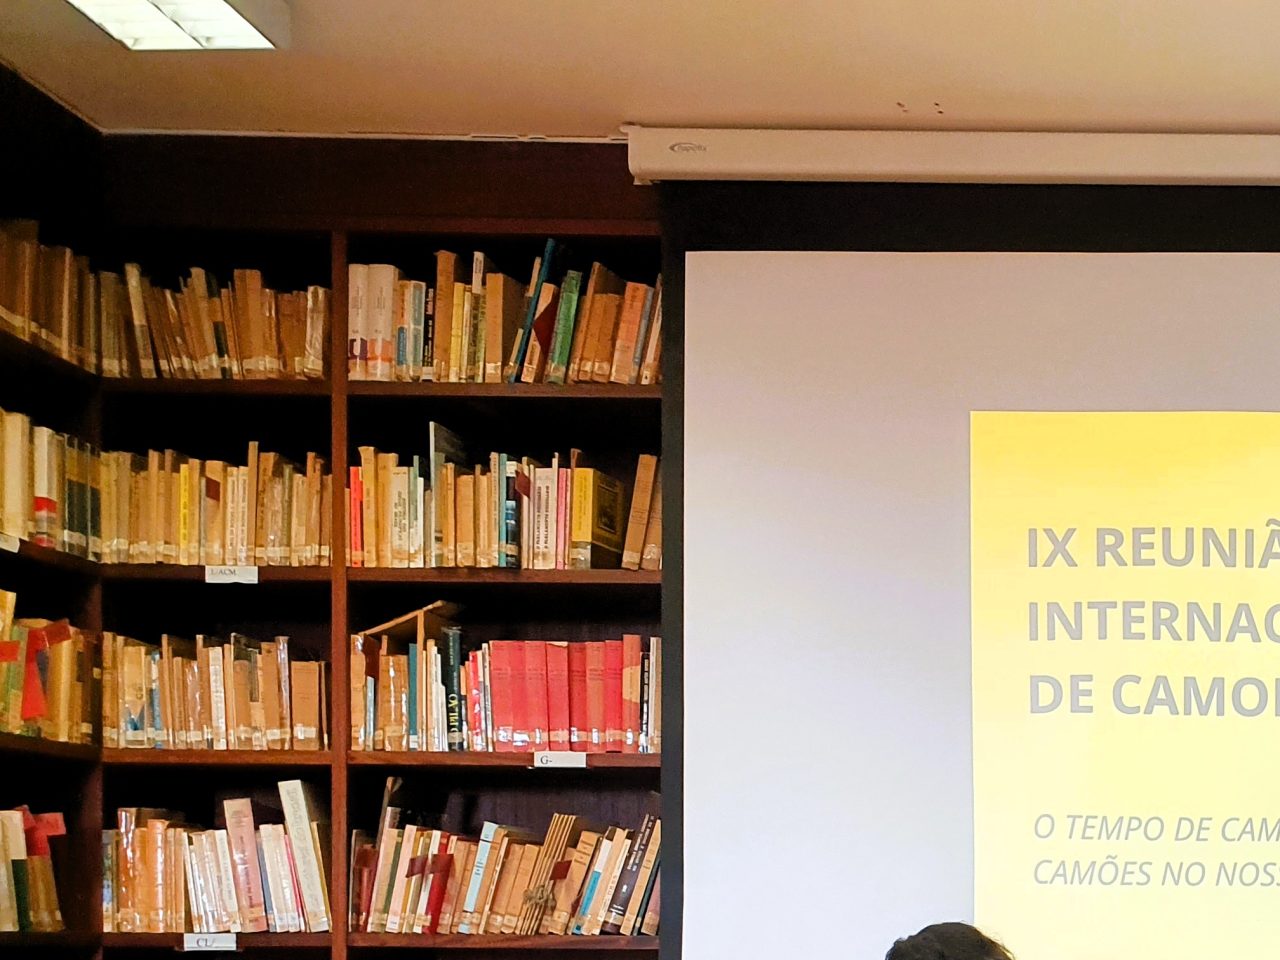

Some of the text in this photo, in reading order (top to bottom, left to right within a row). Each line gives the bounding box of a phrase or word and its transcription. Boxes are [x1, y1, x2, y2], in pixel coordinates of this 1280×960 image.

[1027, 527, 1079, 568] IX
[1029, 674, 1094, 714] DE
[1034, 813, 1055, 840] O
[1066, 814, 1165, 842] TEMPO
[1174, 815, 1213, 842] DE
[1033, 854, 1153, 887] CAMÕES
[1161, 861, 1206, 887] NO
